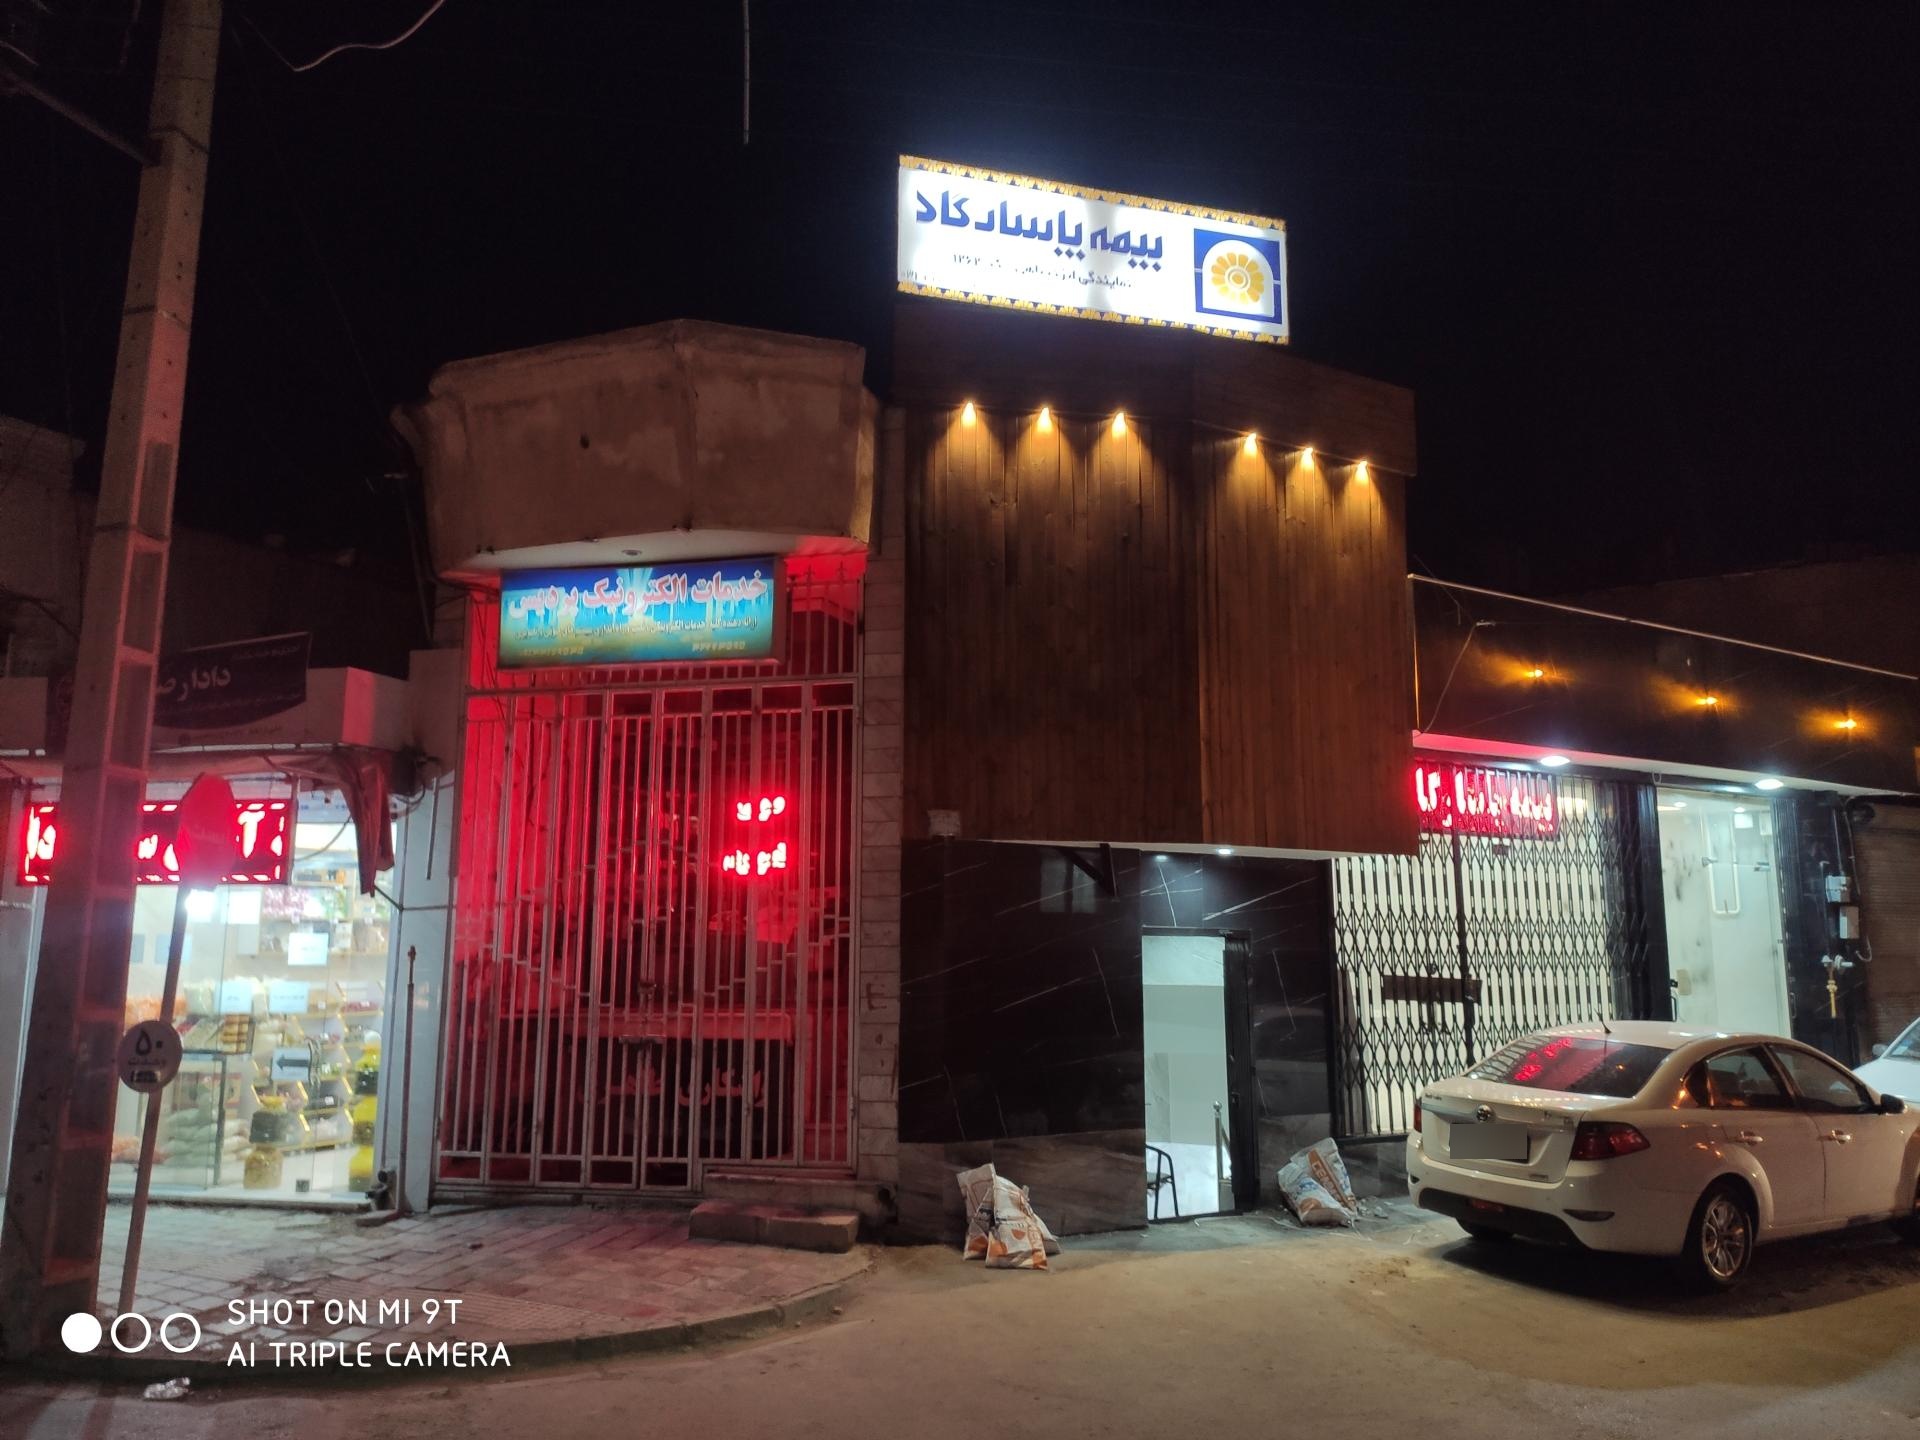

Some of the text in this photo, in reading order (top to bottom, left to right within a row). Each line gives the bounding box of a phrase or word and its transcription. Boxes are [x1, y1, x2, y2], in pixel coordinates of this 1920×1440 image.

[916, 189, 1163, 272] بیمه پاسارگاد
[583, 573, 688, 615] الکترونیک
[691, 570, 767, 603] خدمات
[135, 1028, 164, 1056] ۵۰
